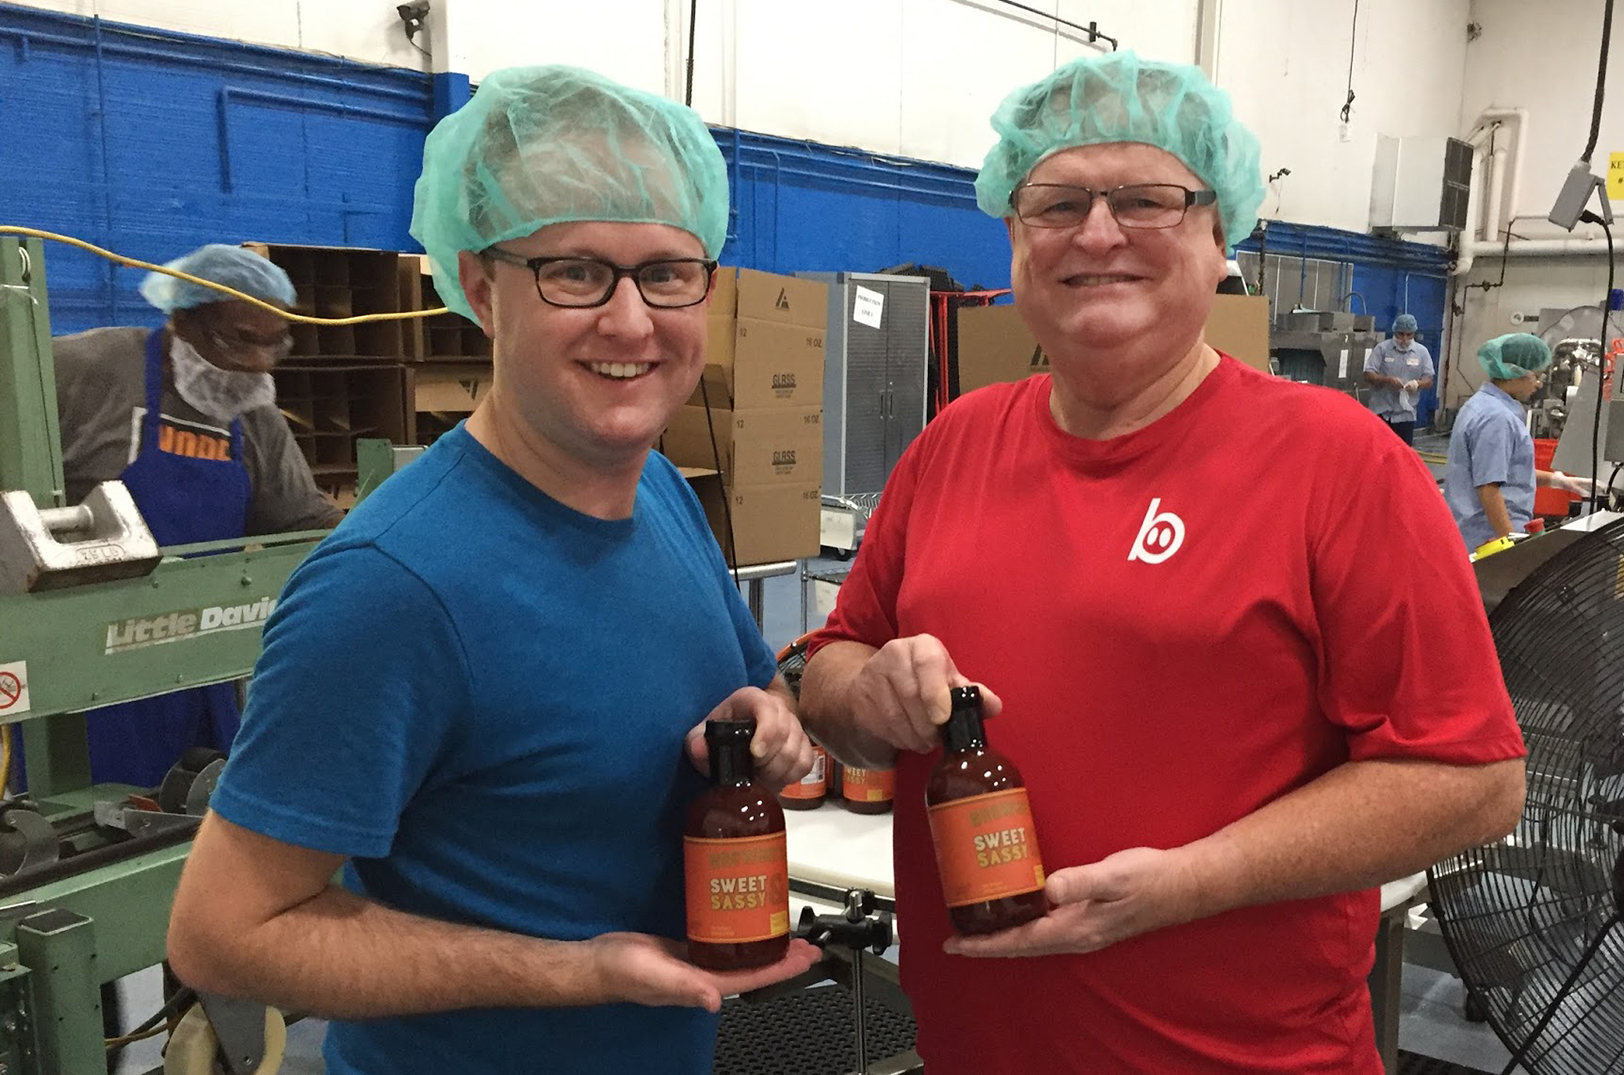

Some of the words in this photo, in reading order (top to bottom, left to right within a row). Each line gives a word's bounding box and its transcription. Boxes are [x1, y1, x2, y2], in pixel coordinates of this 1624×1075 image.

[1611, 160, 1624, 169] KE
[740, 328, 747, 337] 12
[806, 337, 813, 346] 16
[813, 338, 822, 348] OZ
[736, 420, 744, 429] 12
[803, 415, 810, 424] 16
[811, 415, 820, 424] OZ
[802, 491, 809, 500] 16
[810, 490, 818, 499] OZ
[735, 496, 743, 505] 12
[105, 612, 198, 648] Little
[844, 767, 867, 777] WEET
[974, 827, 1026, 852] SWEET
[977, 843, 1028, 868] SASSY
[710, 875, 767, 894] SWEET
[711, 892, 766, 911] SASSY
